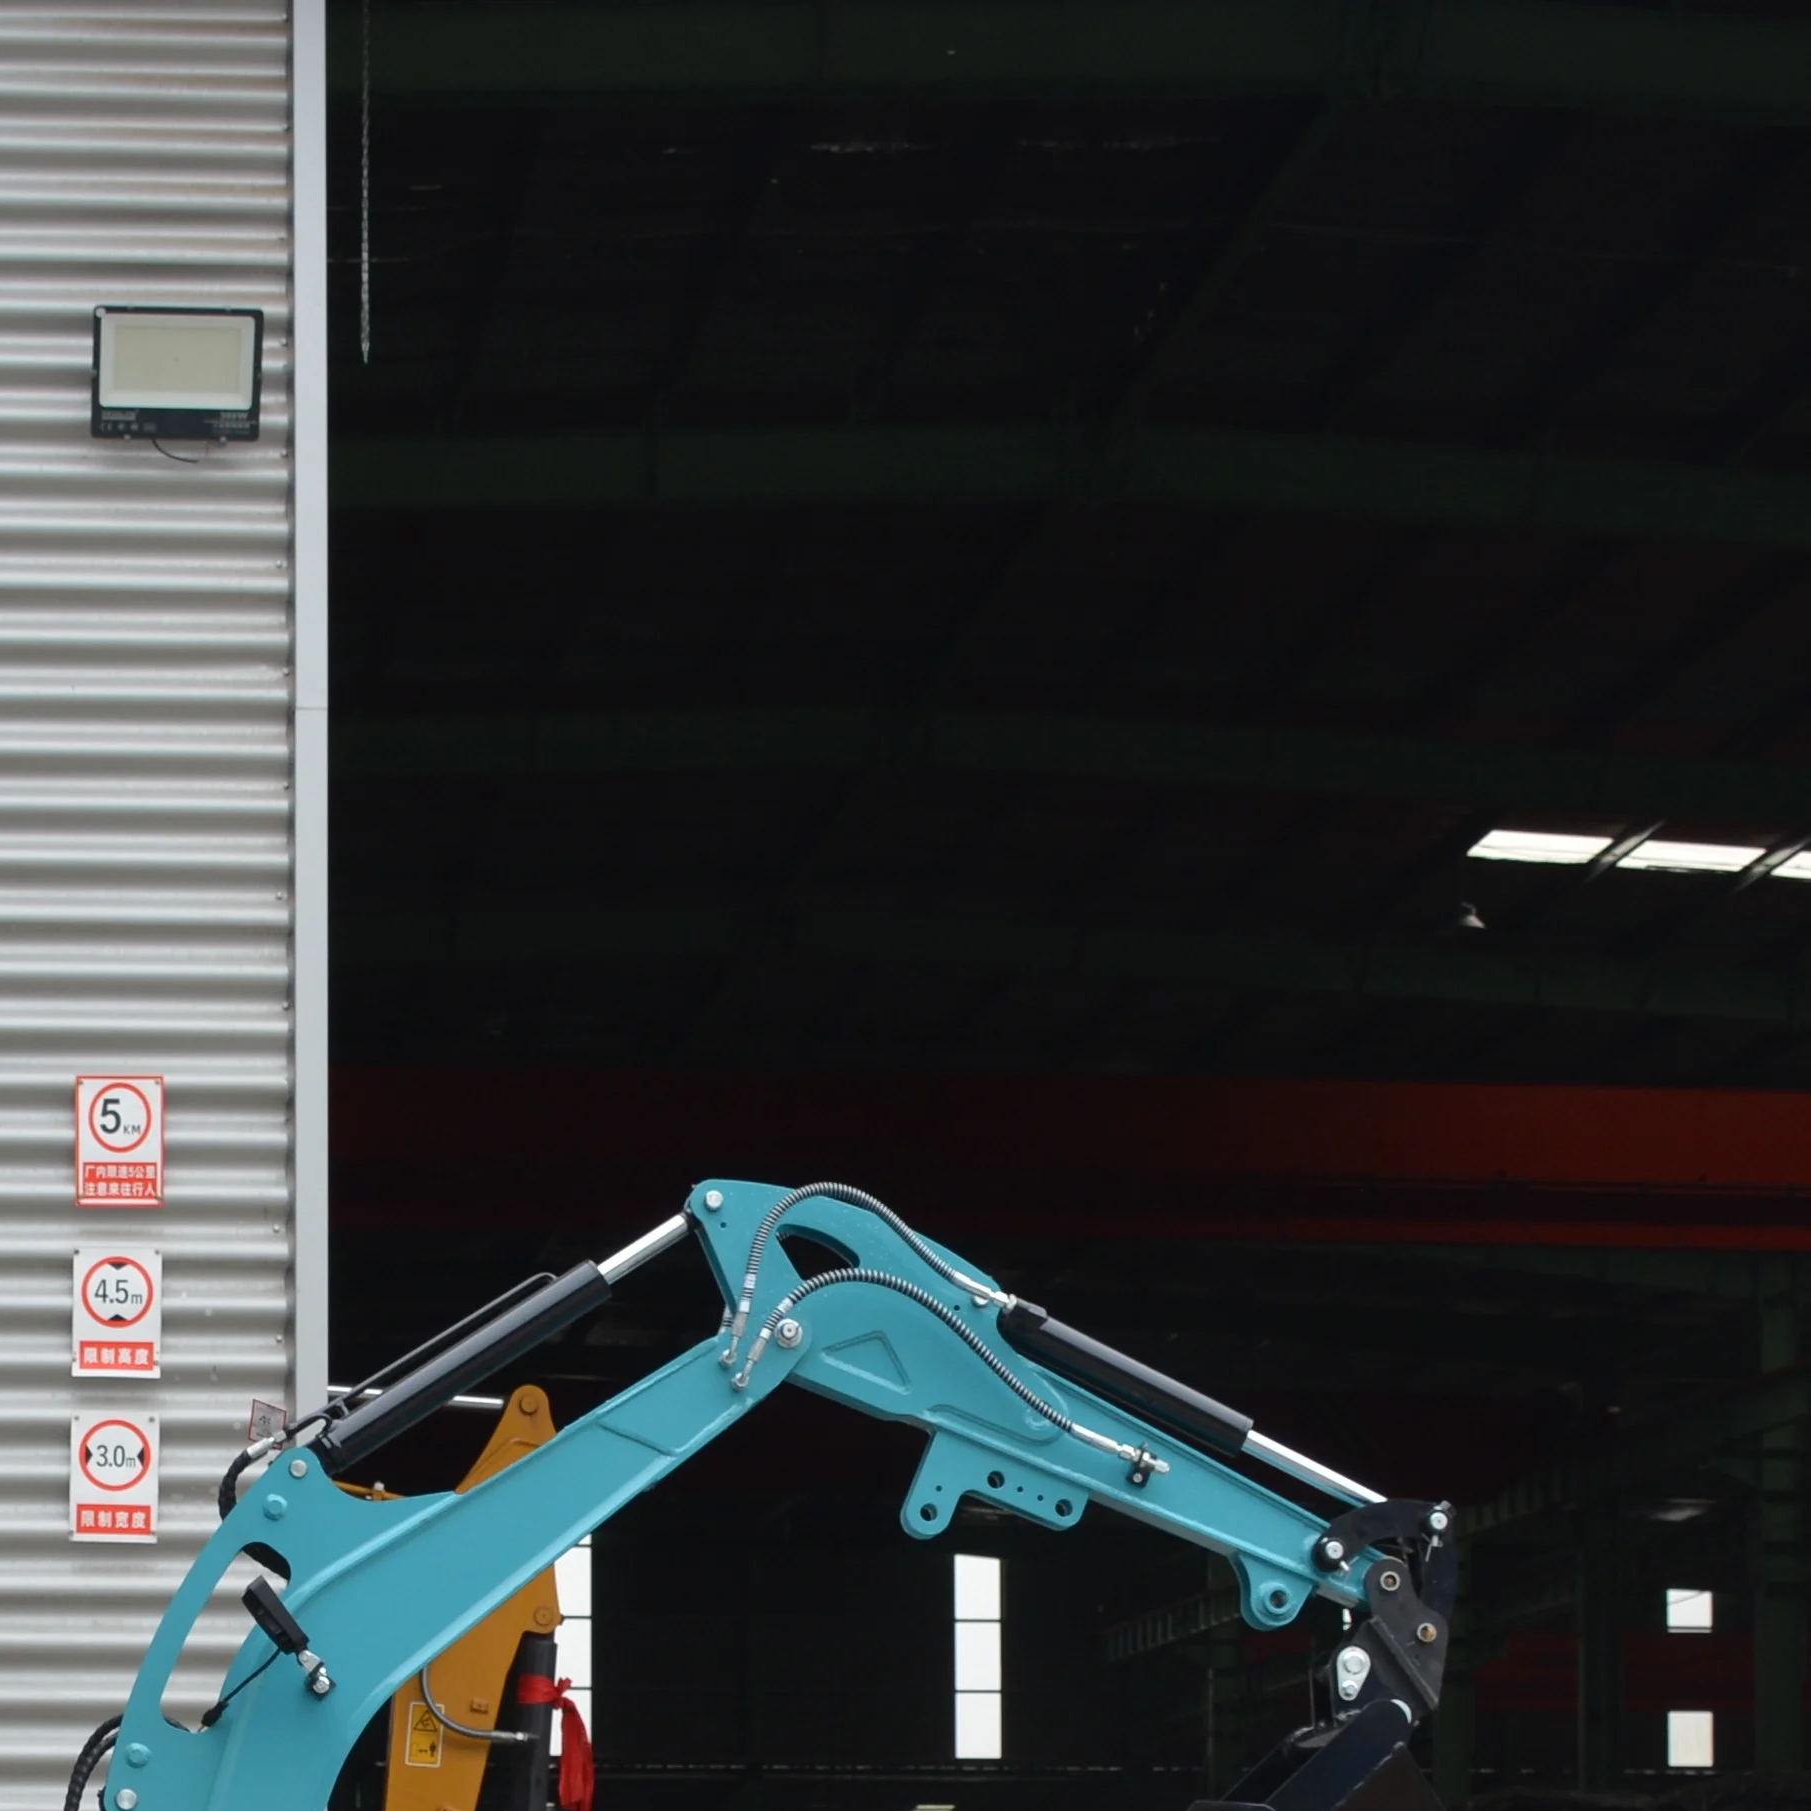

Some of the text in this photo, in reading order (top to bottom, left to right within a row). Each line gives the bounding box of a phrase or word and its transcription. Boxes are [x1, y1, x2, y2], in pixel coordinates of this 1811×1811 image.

[94, 1279, 143, 1304] 4.5m
[83, 1346, 150, 1366] 限制高度
[96, 1444, 136, 1468] 3.0m
[80, 1508, 147, 1530] 限制宽度
